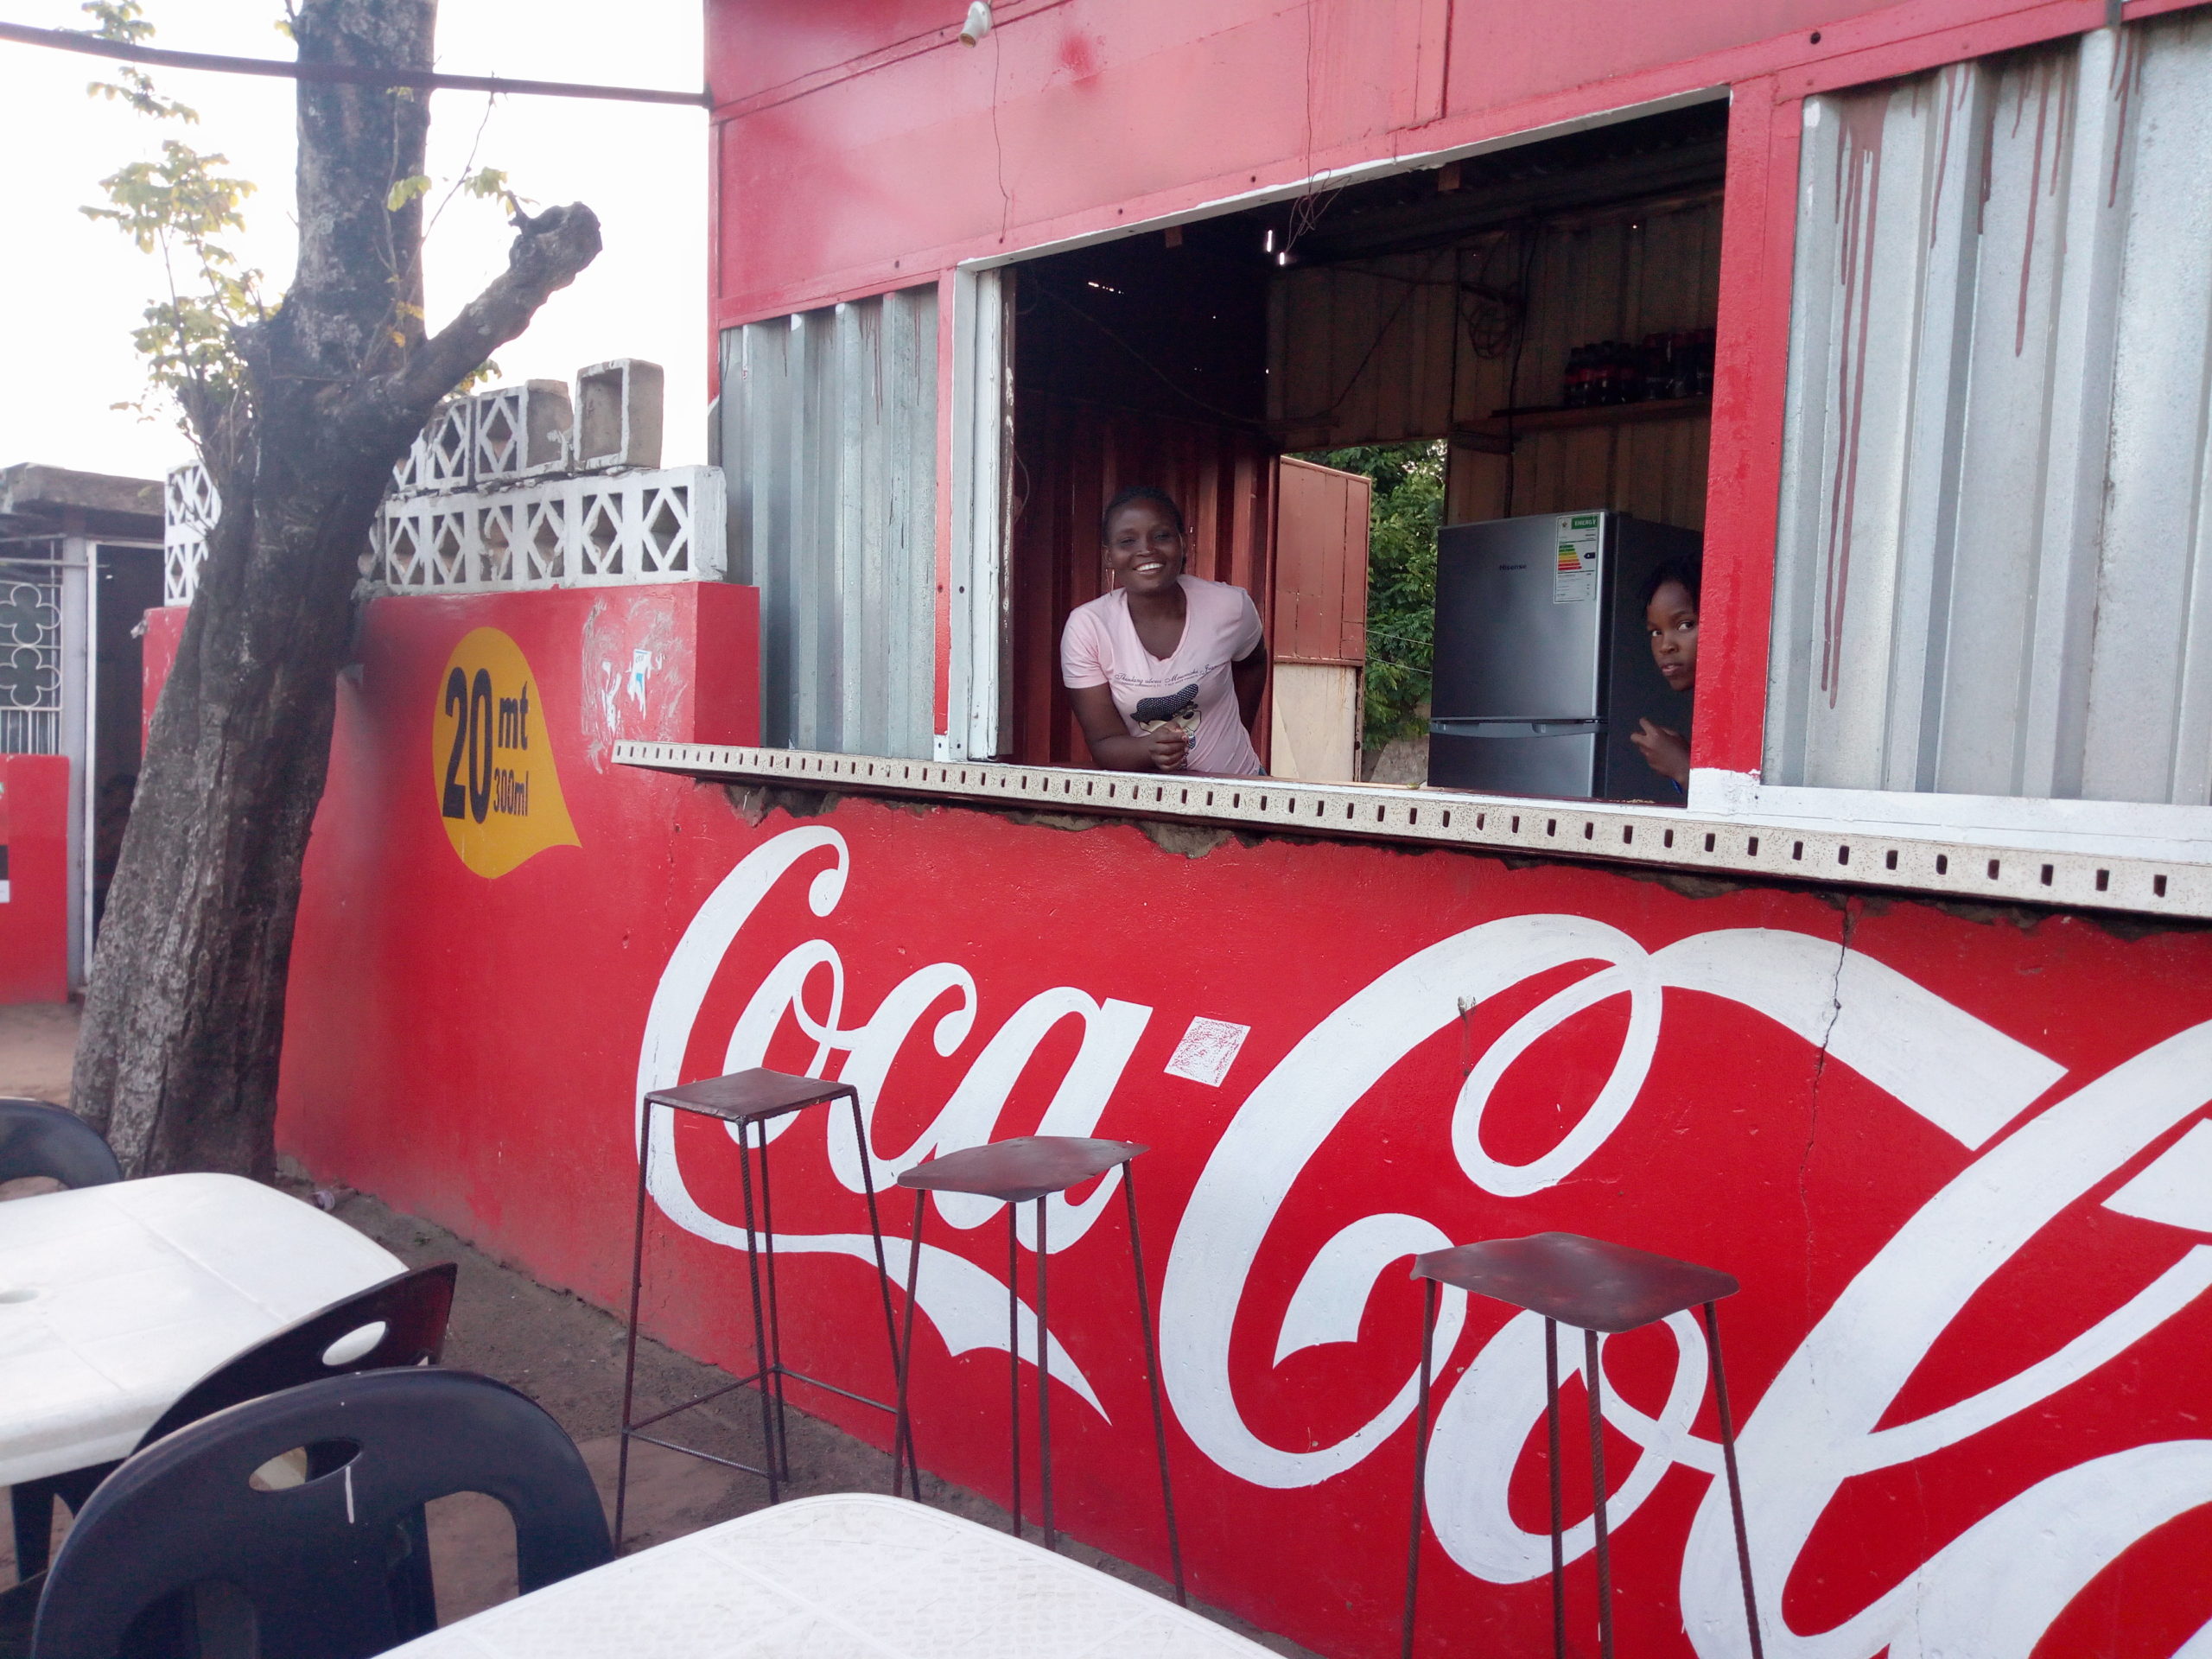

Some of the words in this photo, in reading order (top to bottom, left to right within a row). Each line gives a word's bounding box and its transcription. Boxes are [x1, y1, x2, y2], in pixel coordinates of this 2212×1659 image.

[1574, 518, 1597, 527] ENERGY
[442, 666, 493, 824] 20
[498, 681, 529, 751] mt
[493, 767, 530, 817] 300ml
